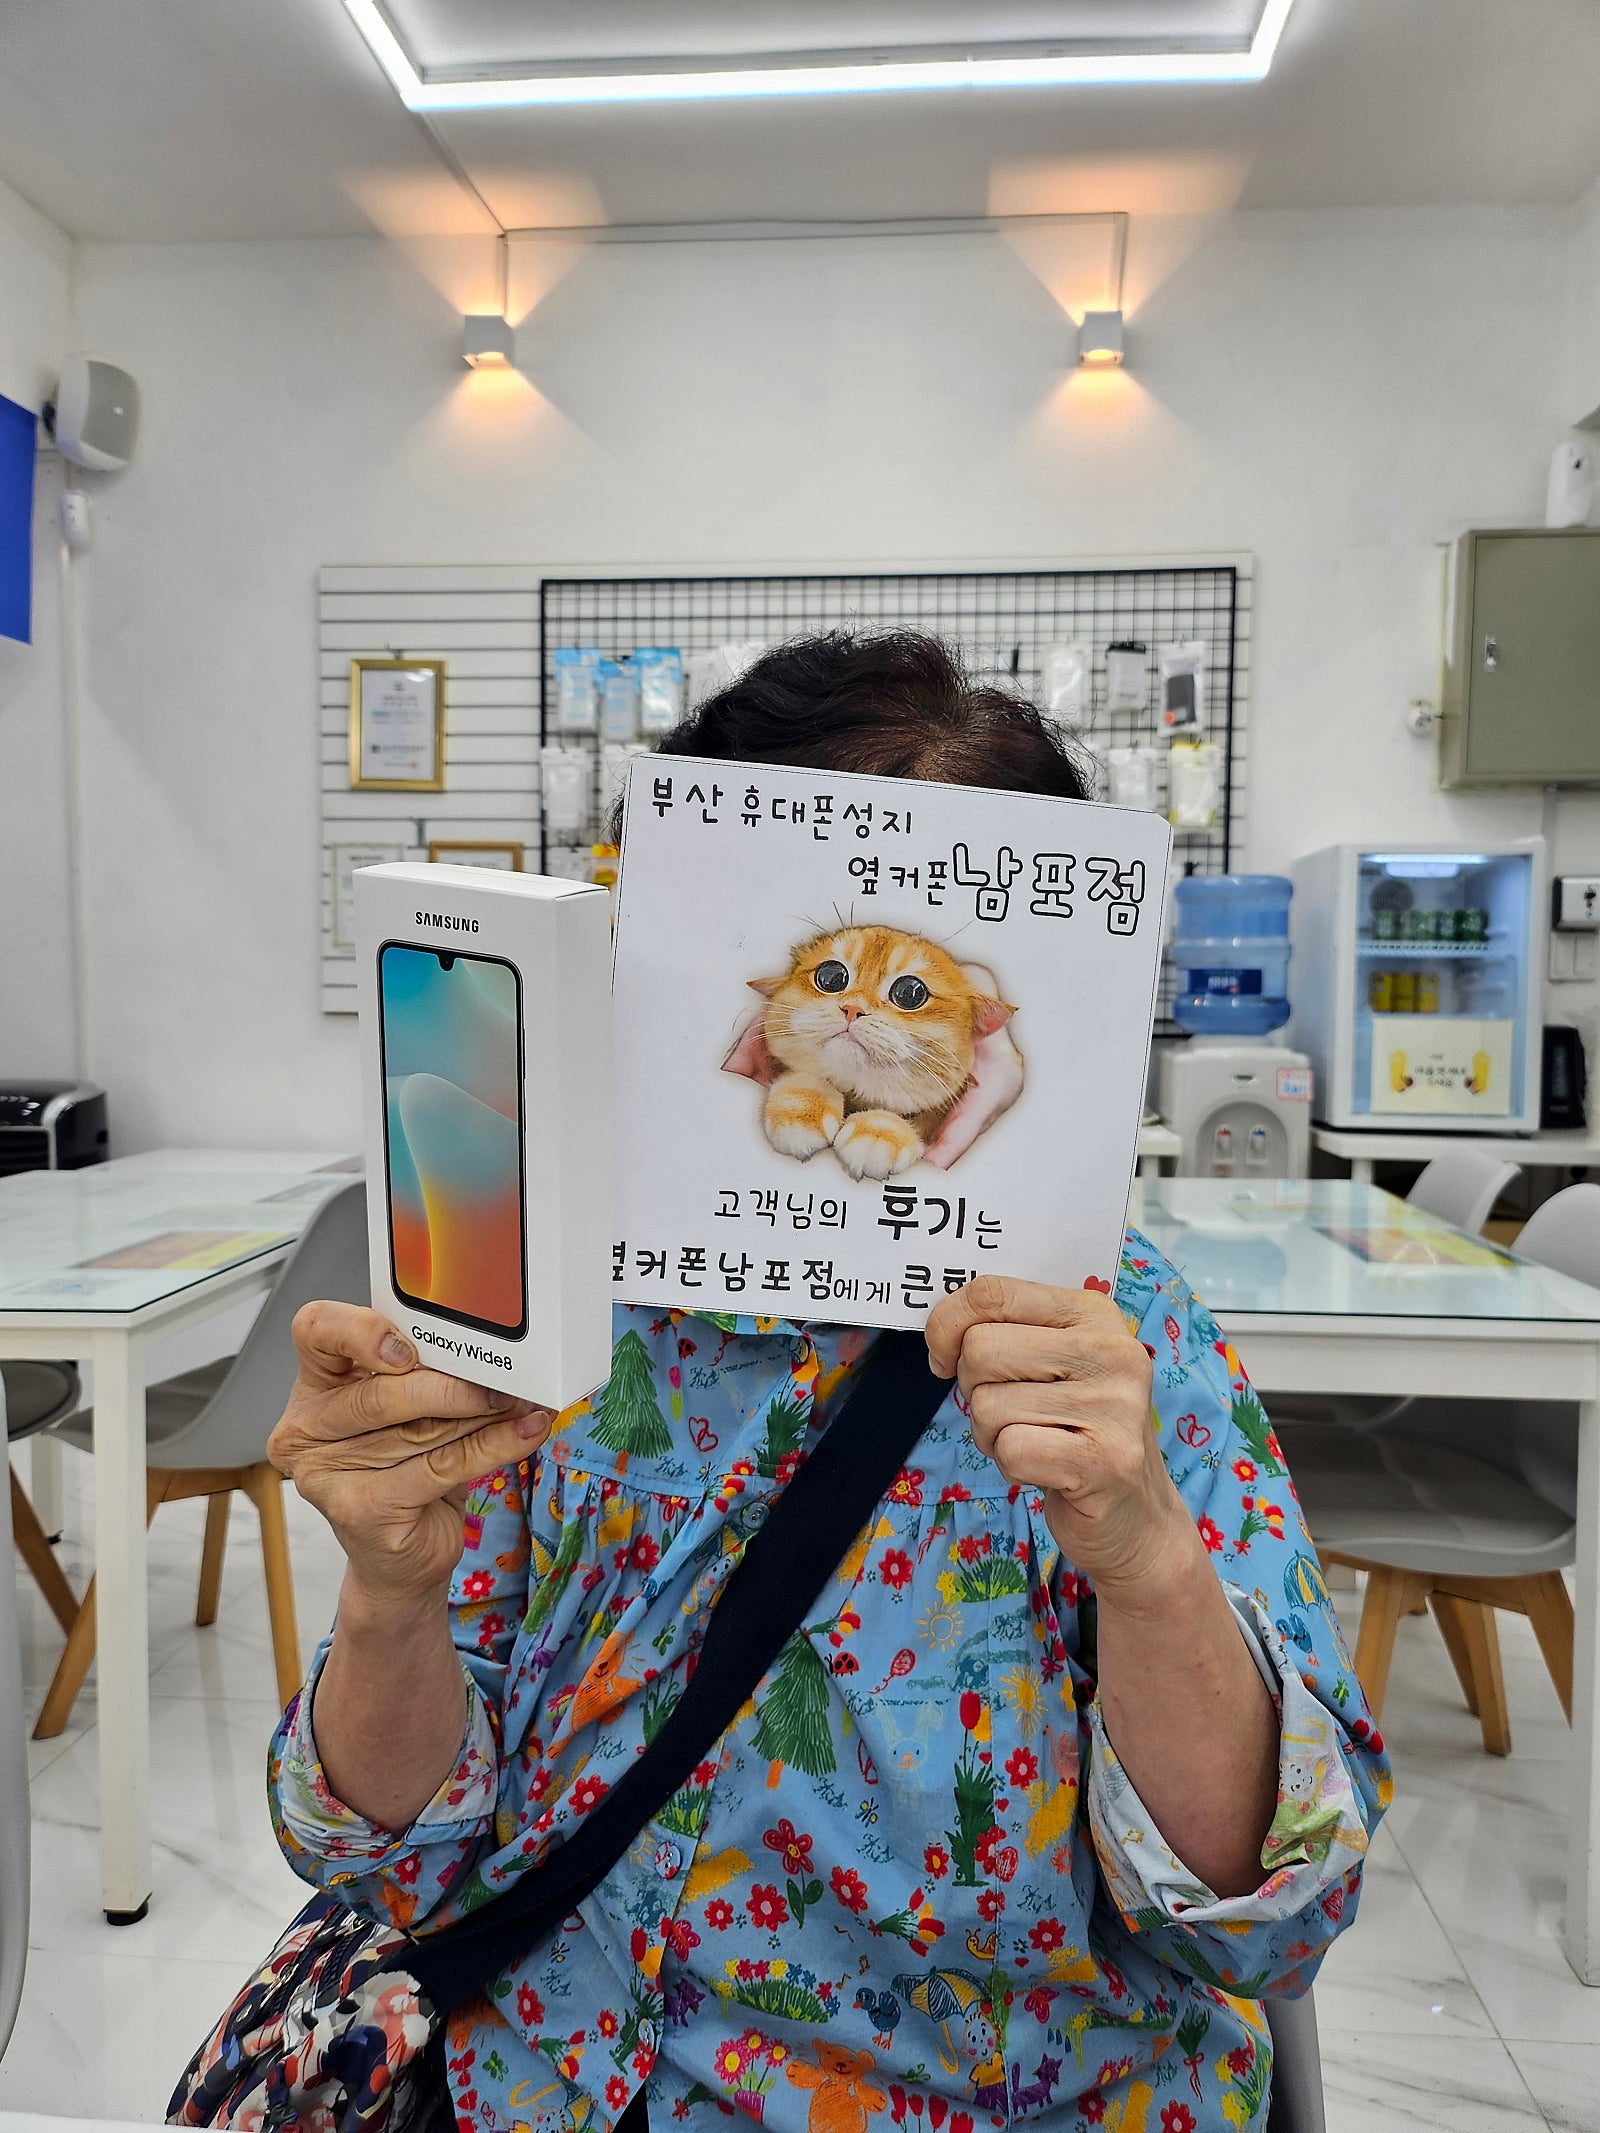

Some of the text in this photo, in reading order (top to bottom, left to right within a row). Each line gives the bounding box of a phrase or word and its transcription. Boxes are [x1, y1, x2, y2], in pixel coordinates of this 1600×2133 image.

[652, 777, 913, 842] 부산 휴대폰성지
[415, 911, 479, 934] SAMSUNG
[714, 1184, 1003, 1251] 고객님의 후기는
[411, 1325, 514, 1371] Galaxy Wide8
